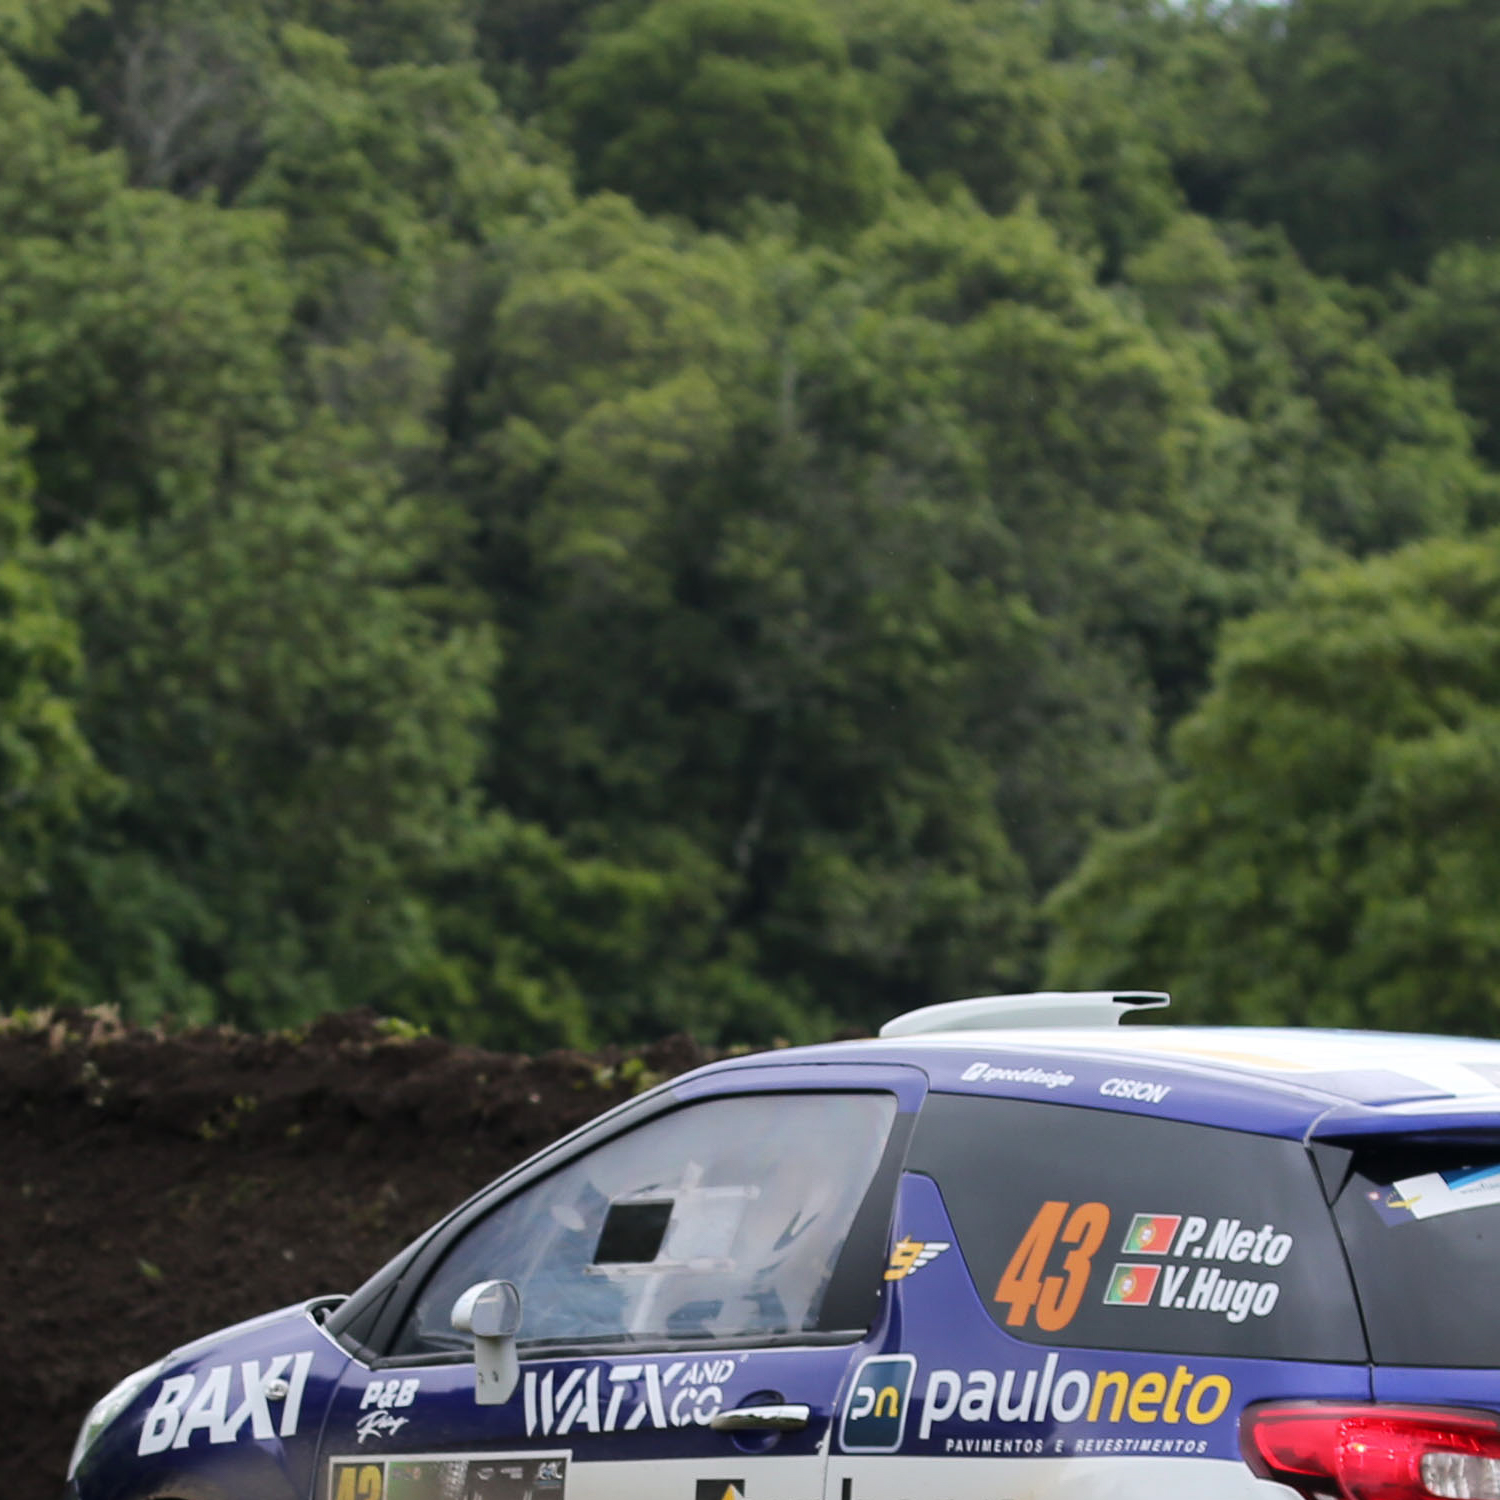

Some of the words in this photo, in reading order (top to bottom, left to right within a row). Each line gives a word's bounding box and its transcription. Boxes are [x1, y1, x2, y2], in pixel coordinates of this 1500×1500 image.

[1099, 1078, 1172, 1104] CISION
[1173, 1215, 1294, 1267] P.Neto
[993, 1200, 1111, 1332] 43
[1159, 1264, 1280, 1324] V.Hugo
[359, 1378, 421, 1410] P&B
[680, 1359, 736, 1387] AND
[918, 1352, 1233, 1440] pauloneto
[137, 1351, 315, 1457] BAXI
[669, 1385, 724, 1428] CO
[945, 1437, 1044, 1454] PAVIMENTOS
[1055, 1439, 1063, 1453] E
[1074, 1437, 1209, 1455] REVESTIMENTOS
